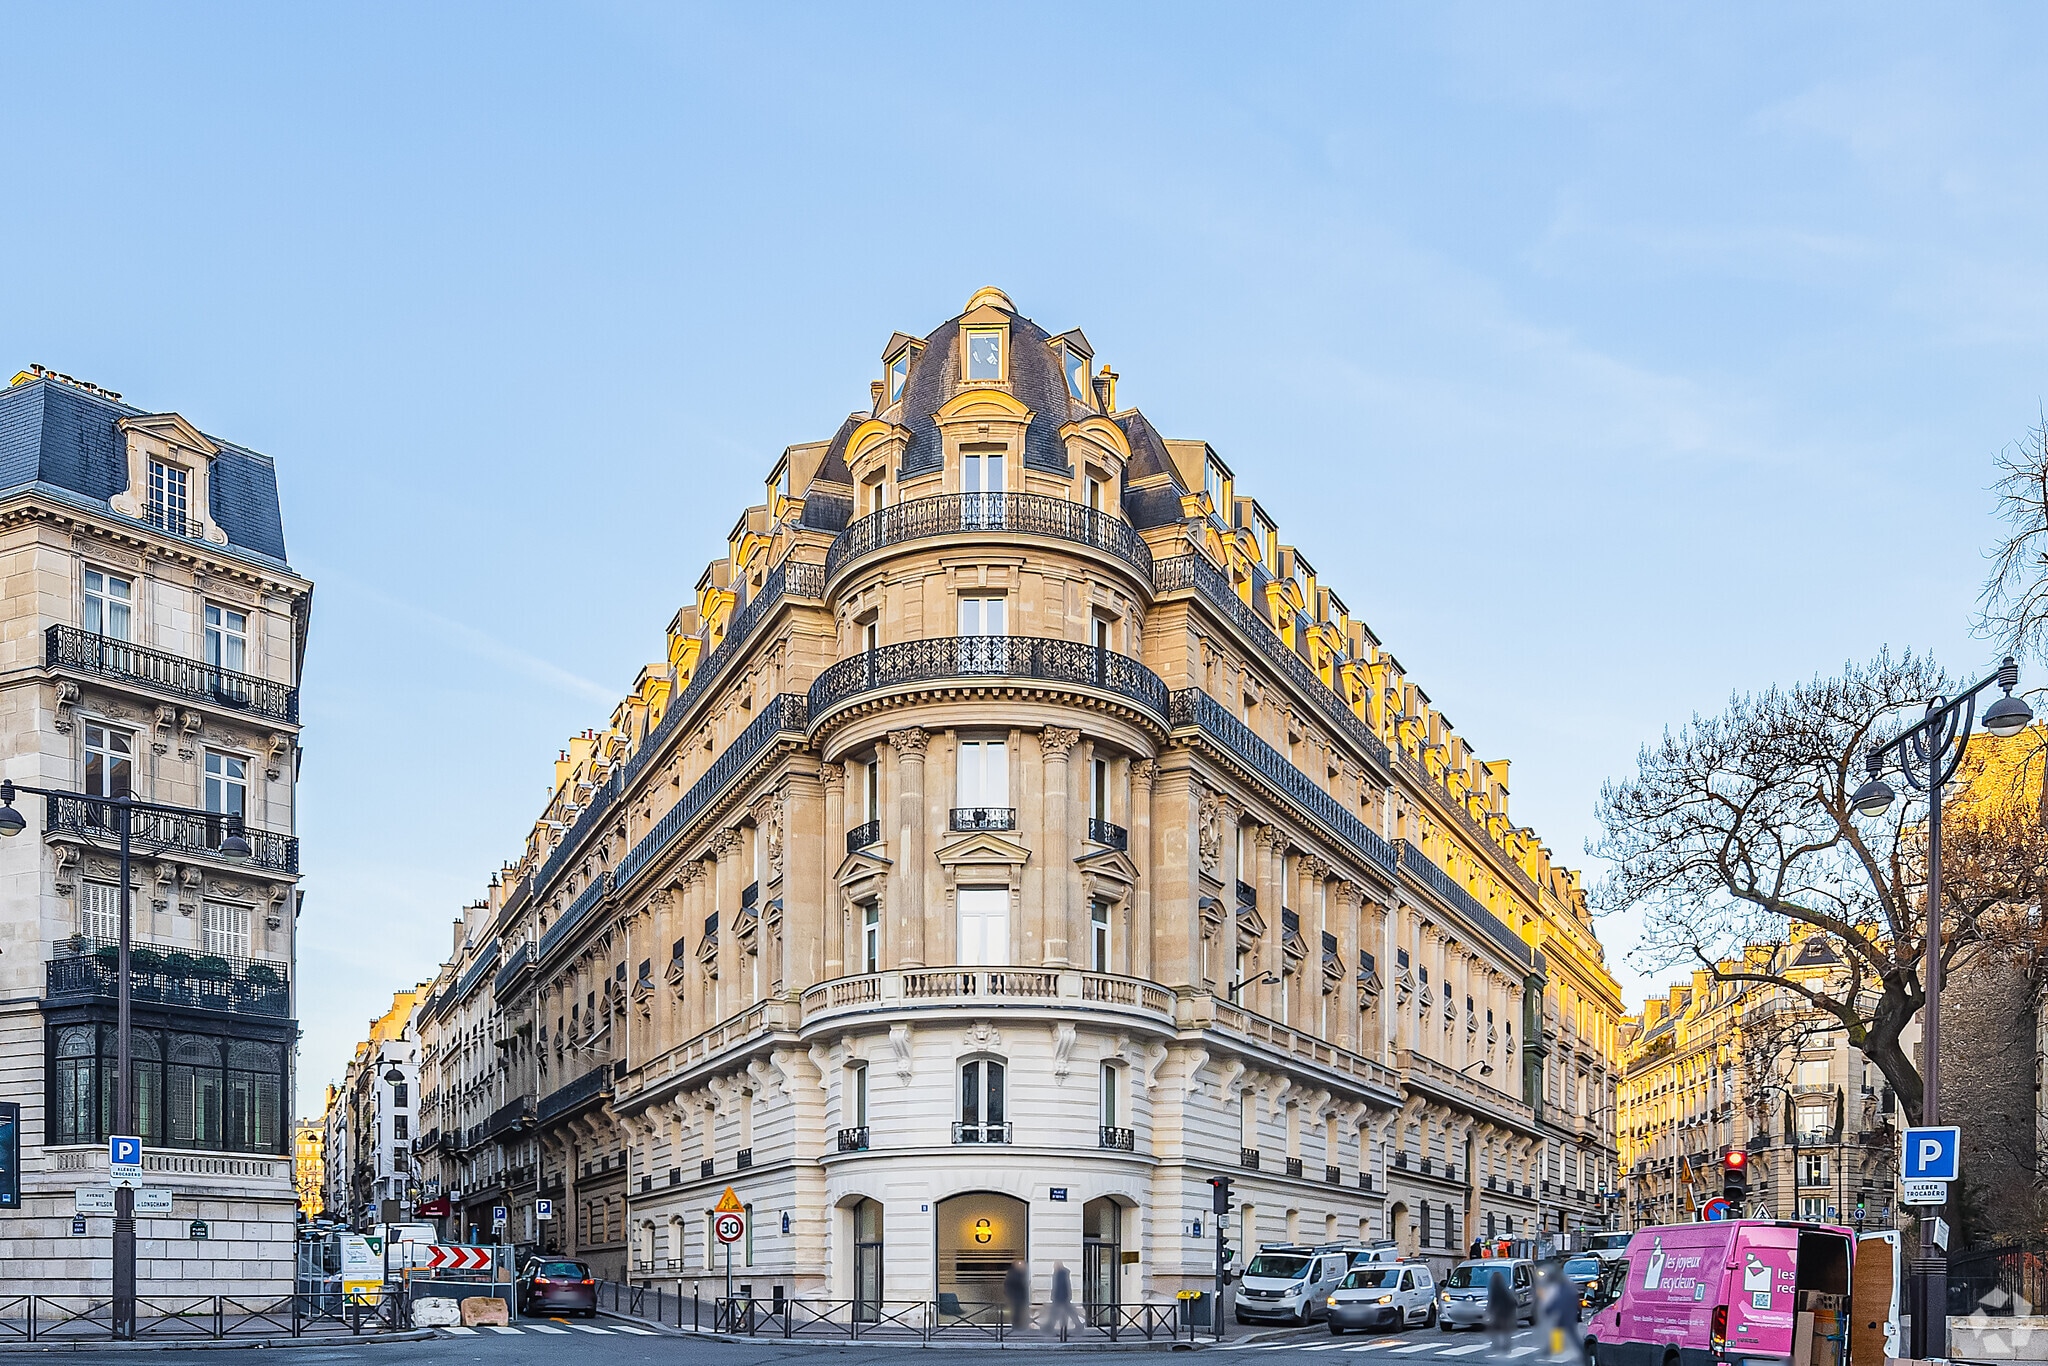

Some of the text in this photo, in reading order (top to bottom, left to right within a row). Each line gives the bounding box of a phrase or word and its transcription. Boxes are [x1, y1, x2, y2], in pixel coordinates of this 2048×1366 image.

[118, 1142, 133, 1160] P
[1918, 1139, 1942, 1171] P
[496, 1209, 503, 1217] P
[540, 1202, 548, 1212] P
[721, 1221, 739, 1234] 30
[1665, 1254, 1701, 1273] les joyeux
[1777, 1268, 1795, 1280] les
[1660, 1273, 1697, 1293] recycleurs
